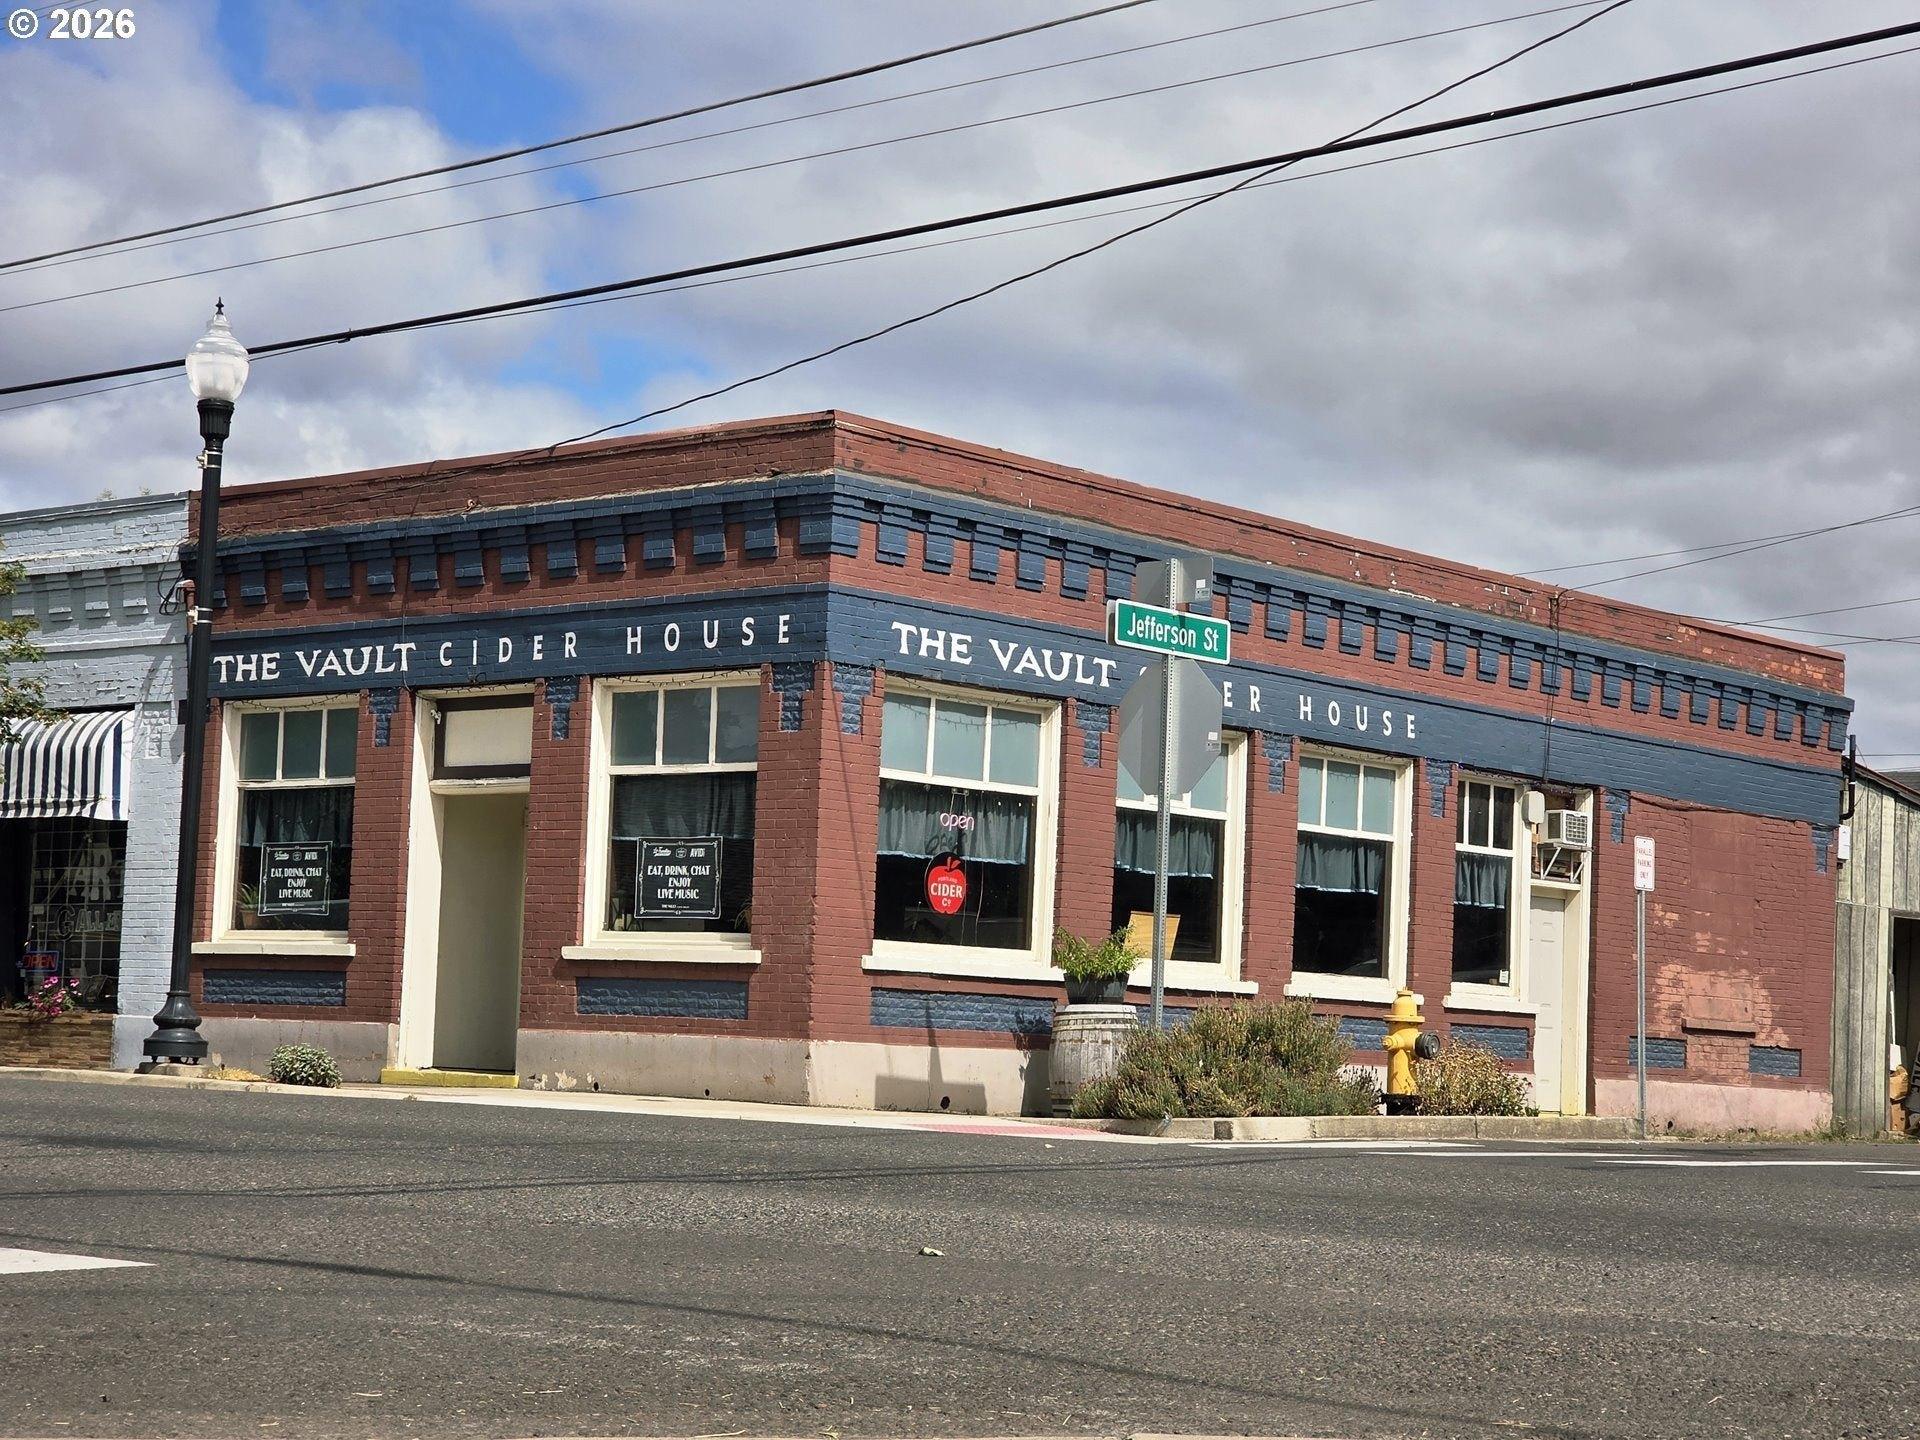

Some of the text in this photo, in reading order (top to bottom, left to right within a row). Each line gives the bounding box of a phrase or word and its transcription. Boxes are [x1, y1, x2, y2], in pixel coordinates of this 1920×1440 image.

[1127, 612, 1219, 652] Jefferson St
[213, 614, 791, 683] THE VAULT CIDER HOUSE
[891, 621, 1117, 687] THE VAULT
[1299, 694, 1416, 739] HOUSE
[940, 812, 975, 831] open
[270, 867, 323, 878] EAT, DRINK, CHAT
[647, 865, 711, 877] EAT, DRINK, CHAT
[287, 878, 307, 888] ENJOY
[668, 877, 692, 887] ENJOY
[930, 882, 963, 898] CIDER
[278, 888, 313, 898] LIVE MUSIC
[657, 888, 700, 899] LIVE MUSIC
[22, 953, 57, 970] OPEN
